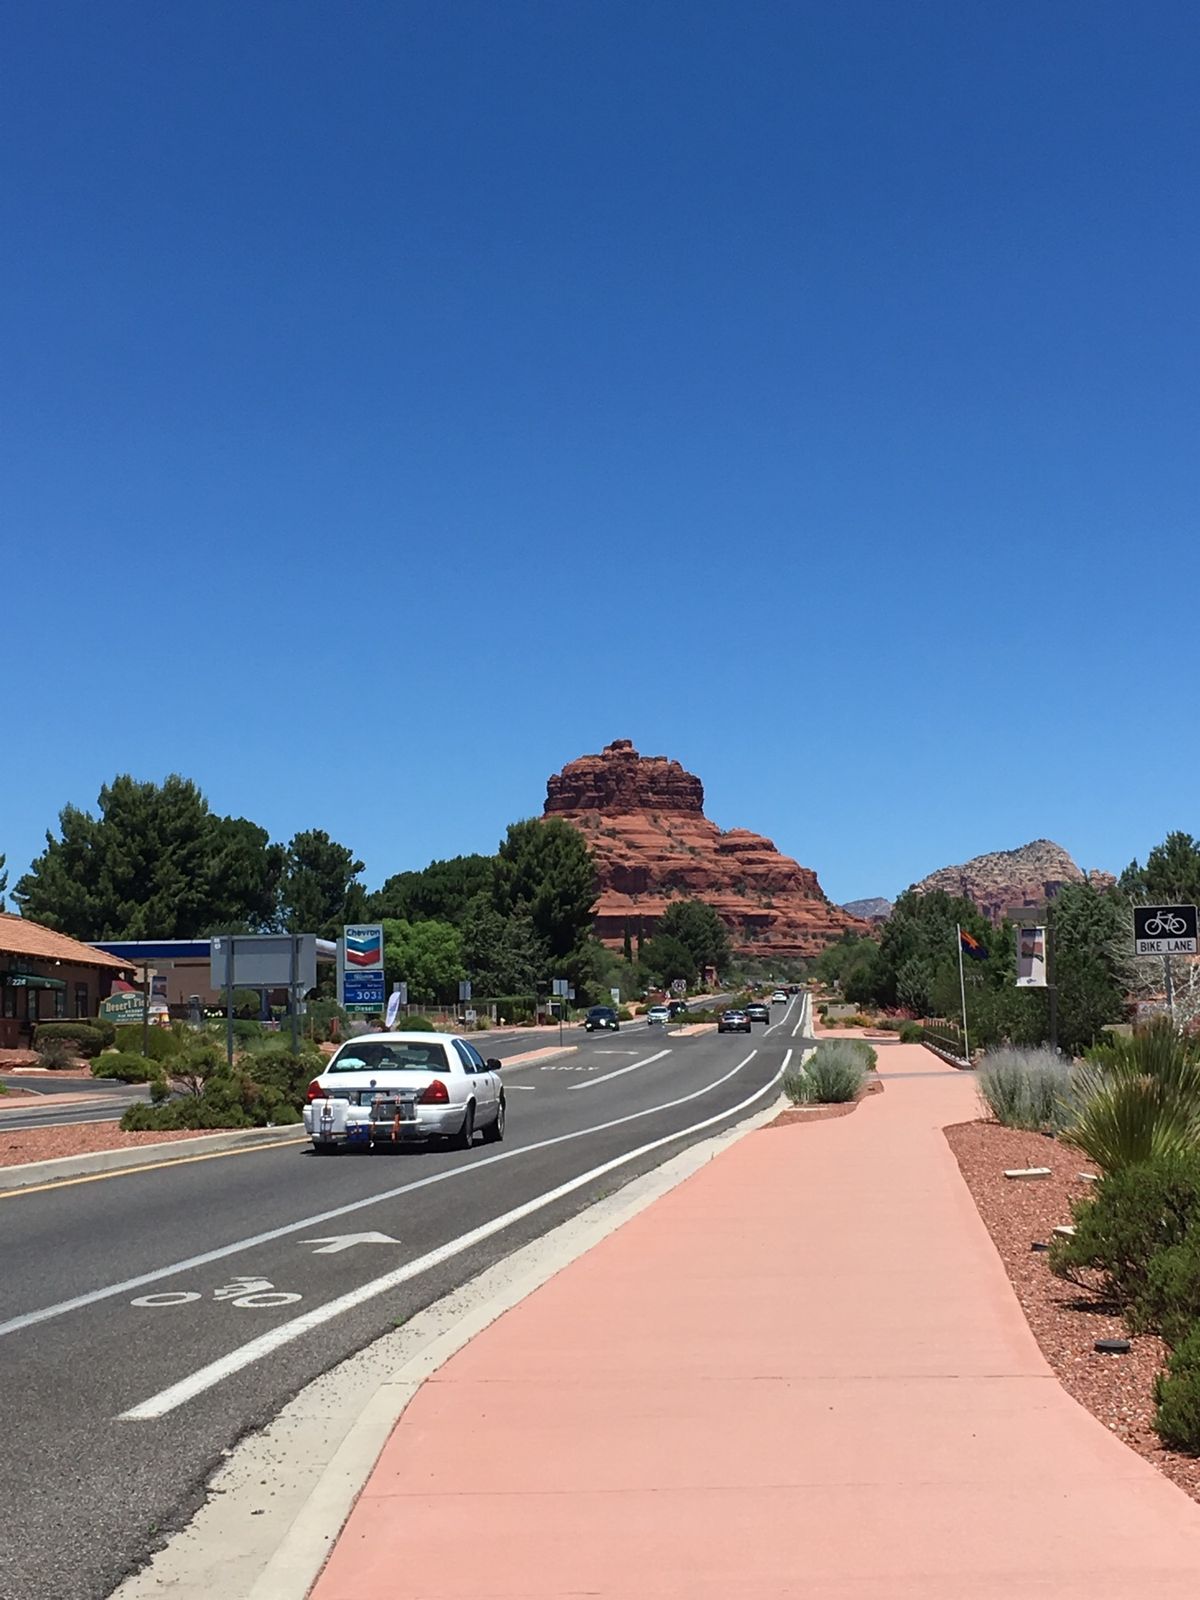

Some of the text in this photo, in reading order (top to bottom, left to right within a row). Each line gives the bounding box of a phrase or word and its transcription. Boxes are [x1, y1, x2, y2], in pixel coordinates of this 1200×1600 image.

[347, 928, 380, 936] Chevron
[1140, 940, 1193, 952] BIKE LANE
[106, 1000, 131, 1012] Desert
